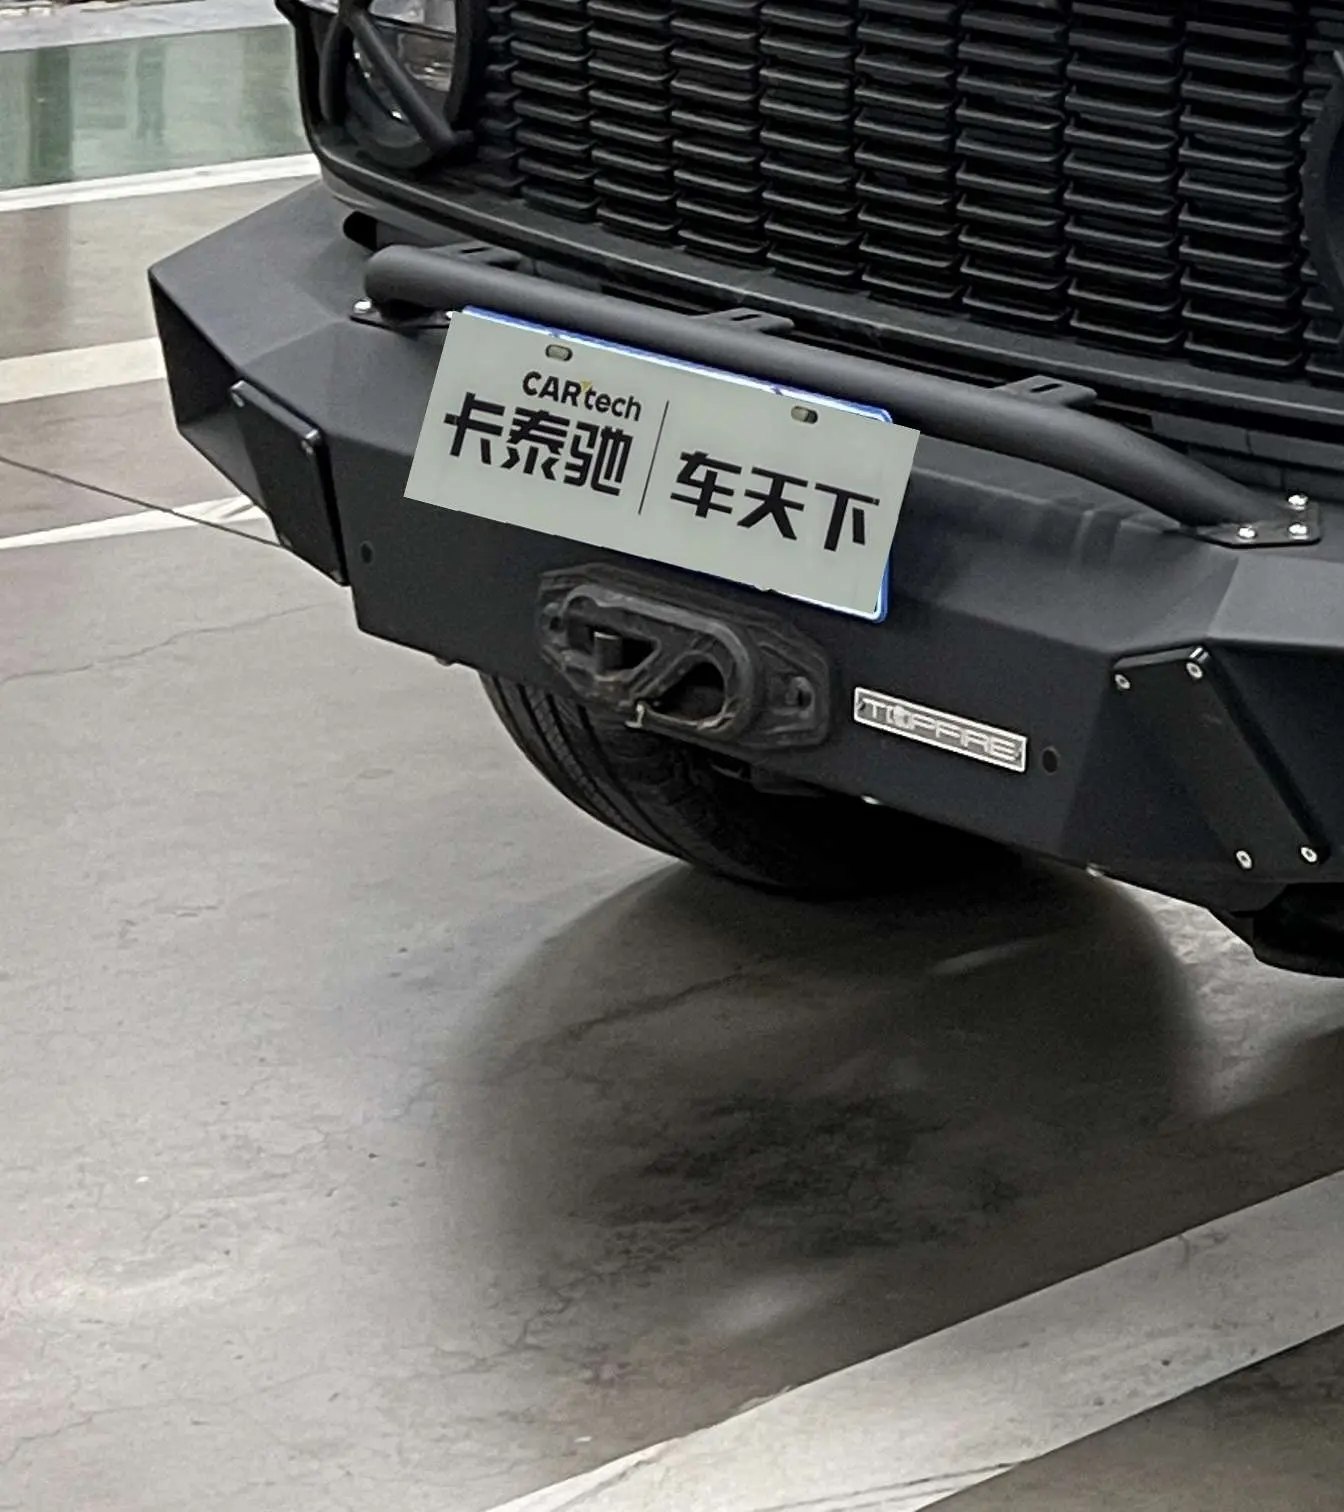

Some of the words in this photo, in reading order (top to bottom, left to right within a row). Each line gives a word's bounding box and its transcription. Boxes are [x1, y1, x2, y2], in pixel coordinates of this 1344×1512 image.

[522, 371, 642, 422] CARtech
[443, 392, 634, 497] 卡泰驰
[670, 451, 880, 552] 车天下
